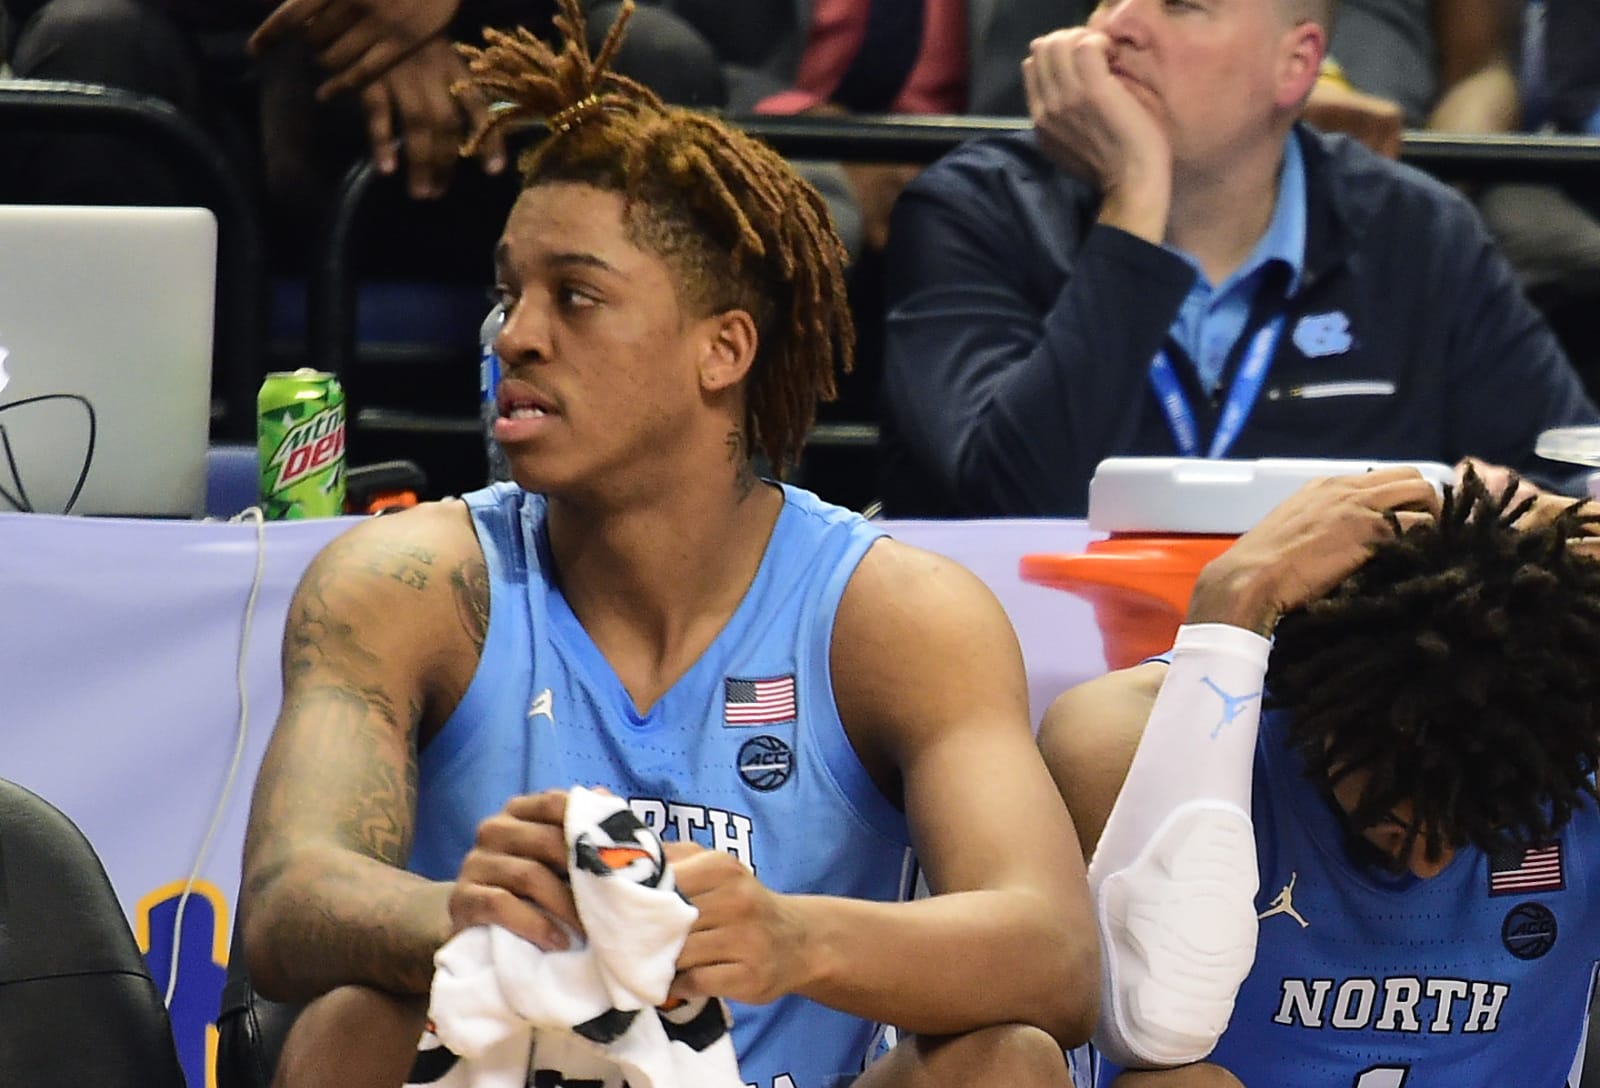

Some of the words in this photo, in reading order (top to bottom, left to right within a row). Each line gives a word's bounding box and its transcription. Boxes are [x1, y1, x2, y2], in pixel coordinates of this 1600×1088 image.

[745, 751, 792, 766] ACC
[629, 797, 757, 874] RTH
[1273, 976, 1511, 1033] NORTH
